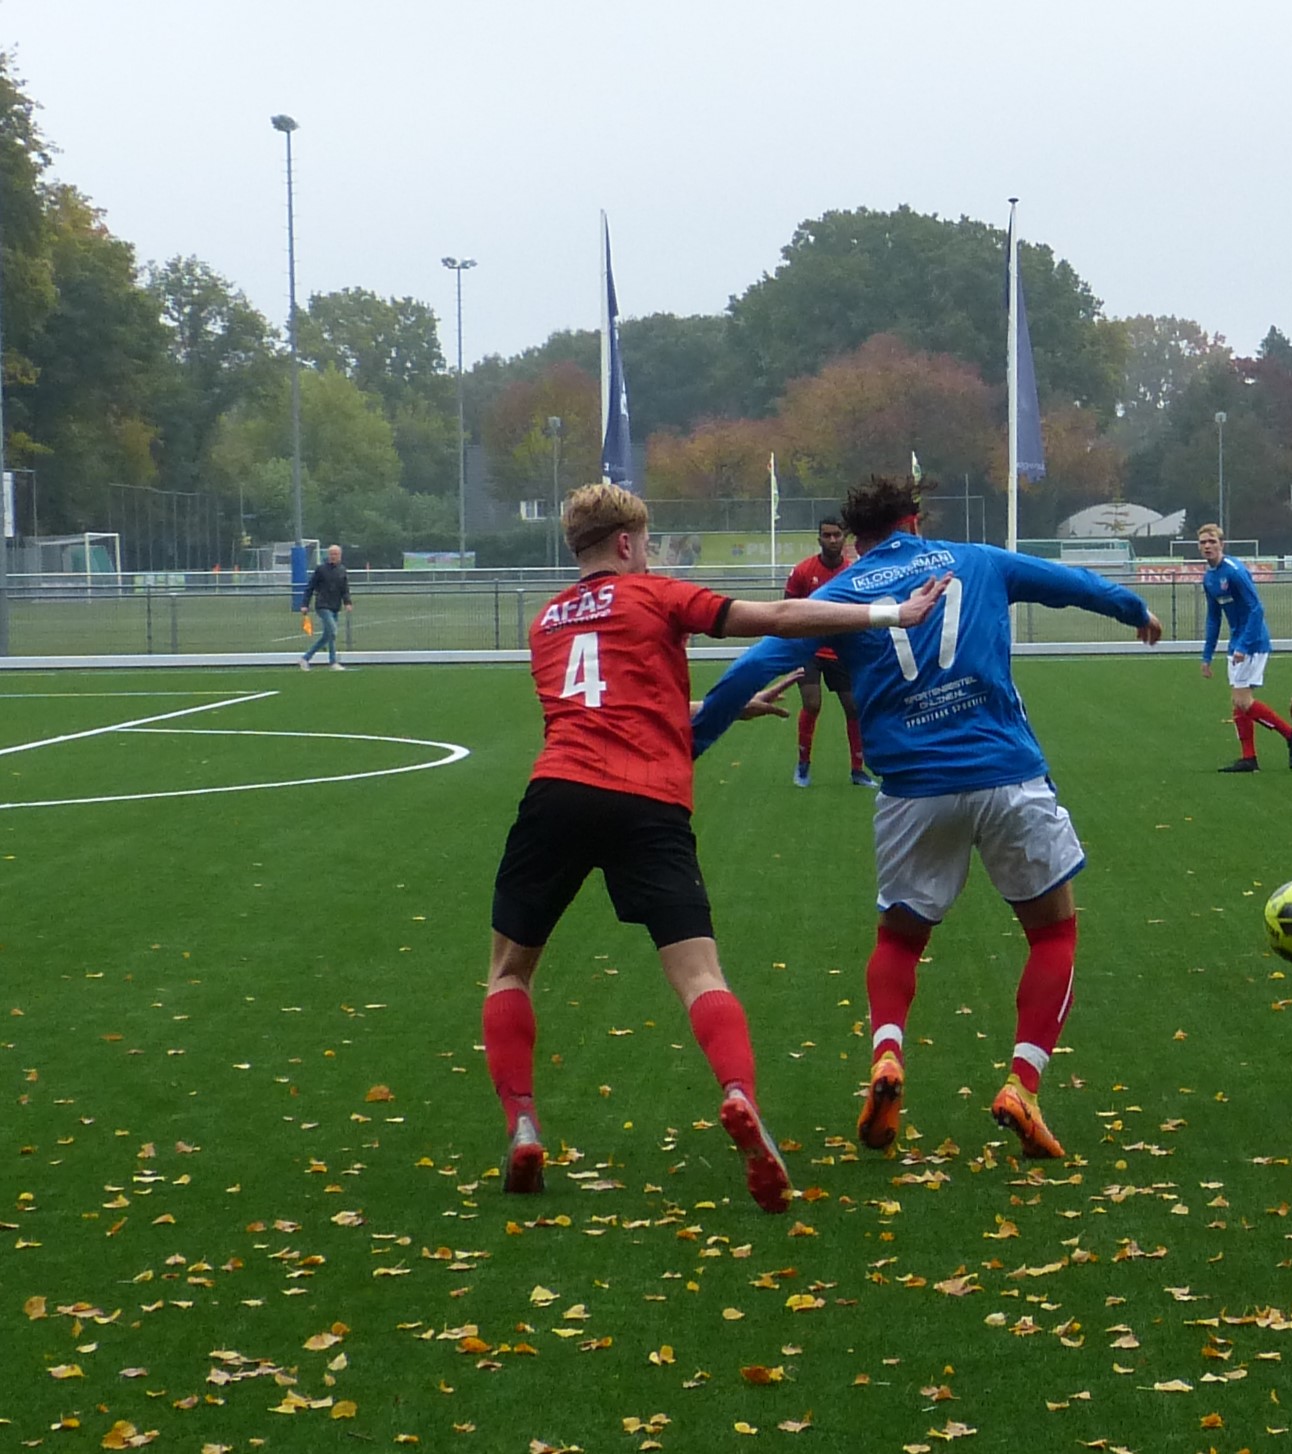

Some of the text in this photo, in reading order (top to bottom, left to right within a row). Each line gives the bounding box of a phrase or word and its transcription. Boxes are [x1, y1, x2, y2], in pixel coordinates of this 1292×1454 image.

[857, 553, 950, 587] KLOOSTERMAN
[1140, 568, 1173, 582] ING
[541, 584, 615, 626] AFAS
[559, 631, 607, 708] 4
